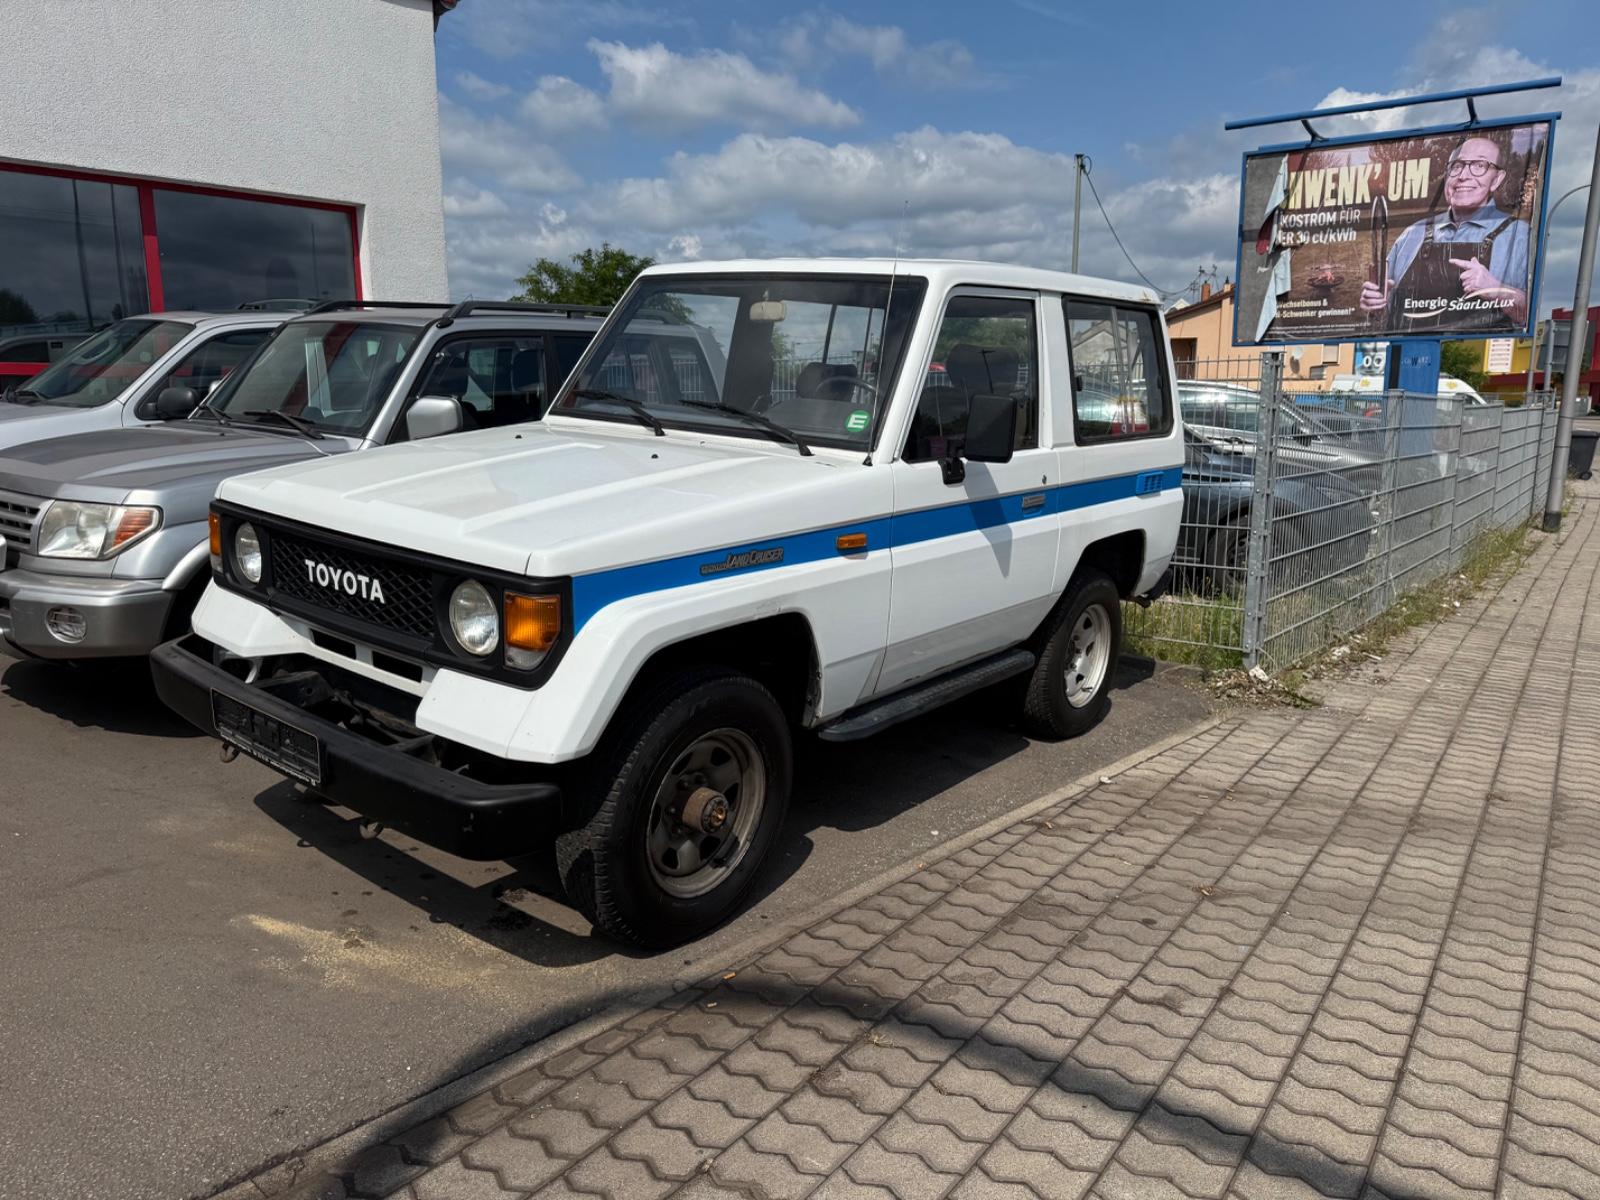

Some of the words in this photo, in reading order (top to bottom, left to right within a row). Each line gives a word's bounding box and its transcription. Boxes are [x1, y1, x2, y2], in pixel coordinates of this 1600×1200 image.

[1387, 157, 1431, 202] UM
[1339, 207, 1361, 224] FÜR
[1296, 230, 1310, 245] 30
[1311, 227, 1357, 245] ct/kWh
[1404, 296, 1448, 310] Energie
[1448, 298, 1515, 311] SaarLorLux
[847, 414, 868, 429] E
[305, 559, 385, 604] TOYOTA
